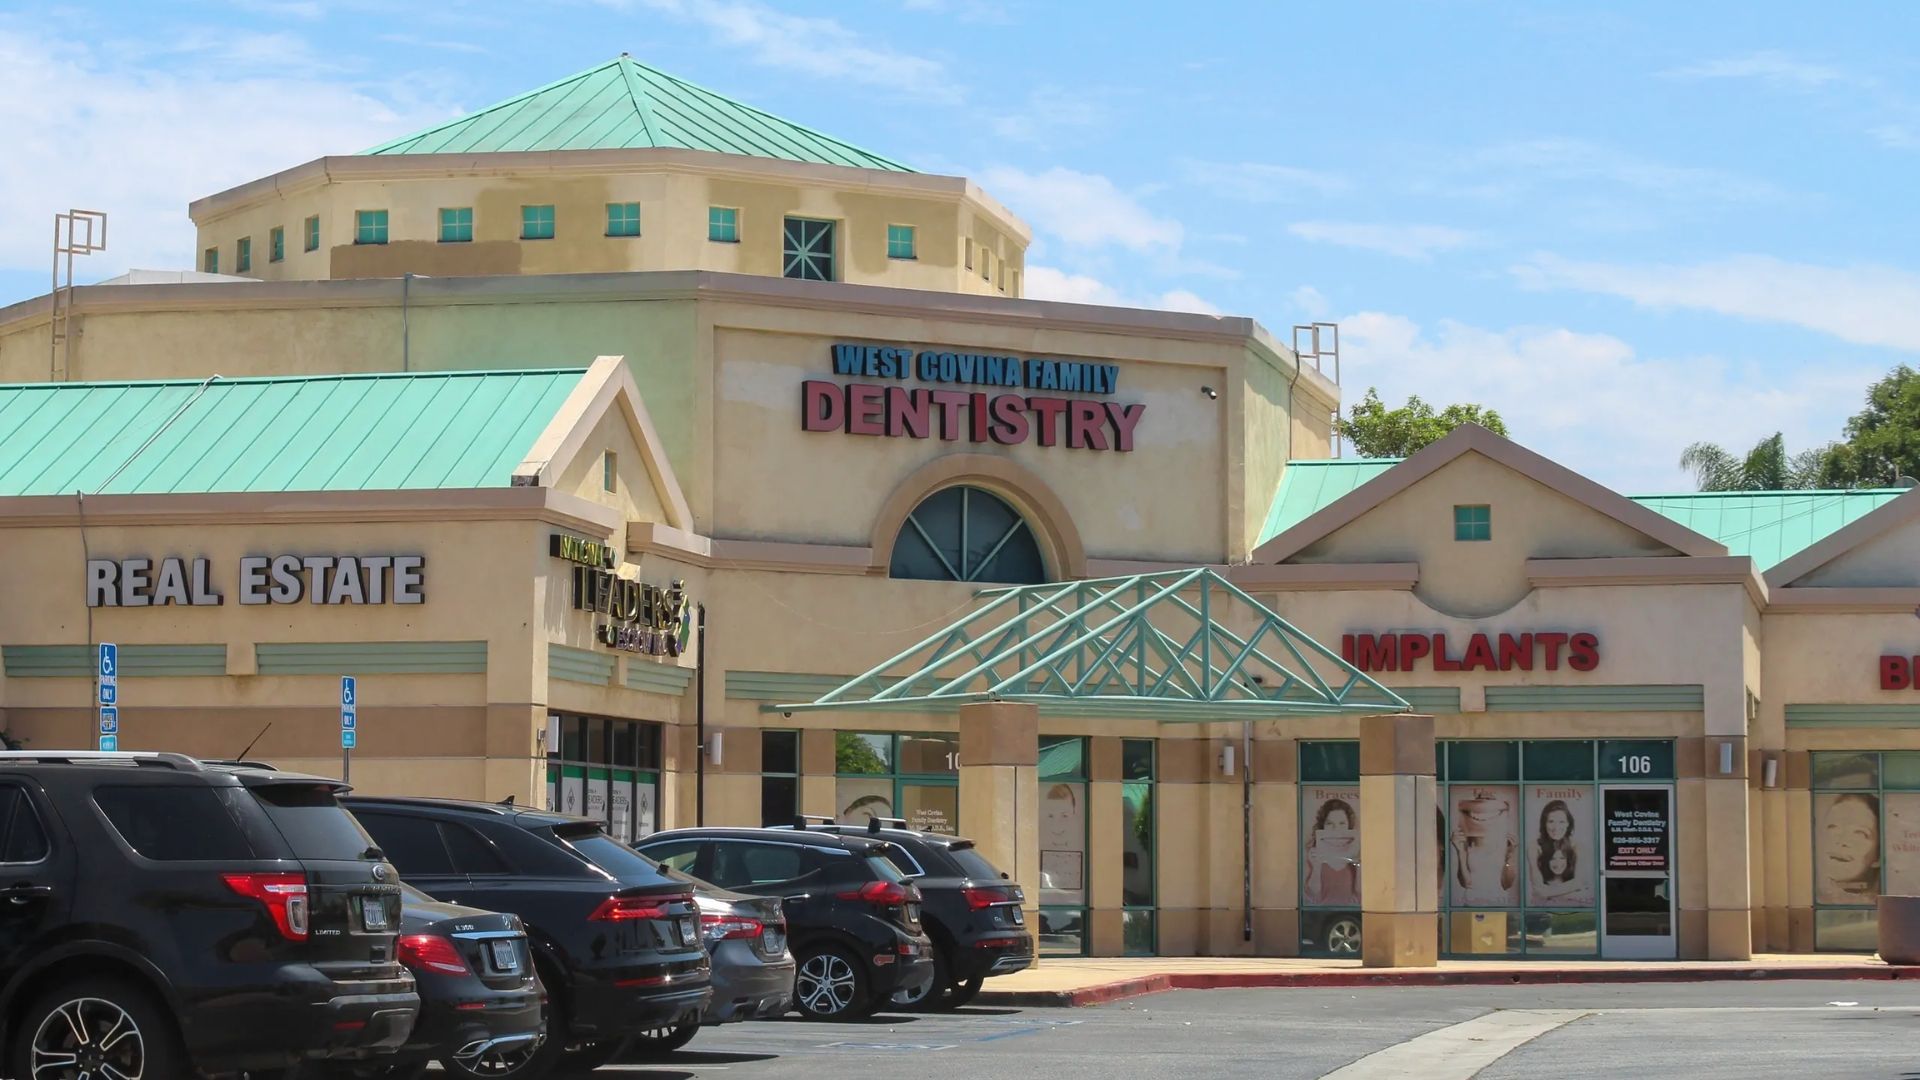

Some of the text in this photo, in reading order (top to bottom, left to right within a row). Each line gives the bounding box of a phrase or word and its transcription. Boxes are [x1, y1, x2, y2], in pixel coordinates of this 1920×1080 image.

[831, 344, 1119, 394] WEST COVINA FAMILY
[801, 380, 1146, 451] DENTISTRY
[86, 555, 425, 607] REAL ESTATE
[573, 566, 676, 631] LEADERS
[1342, 632, 1600, 672] IMPLANTS
[1880, 655, 1920, 690] B
[1618, 755, 1651, 774] 106
[1536, 788, 1585, 800] Family
